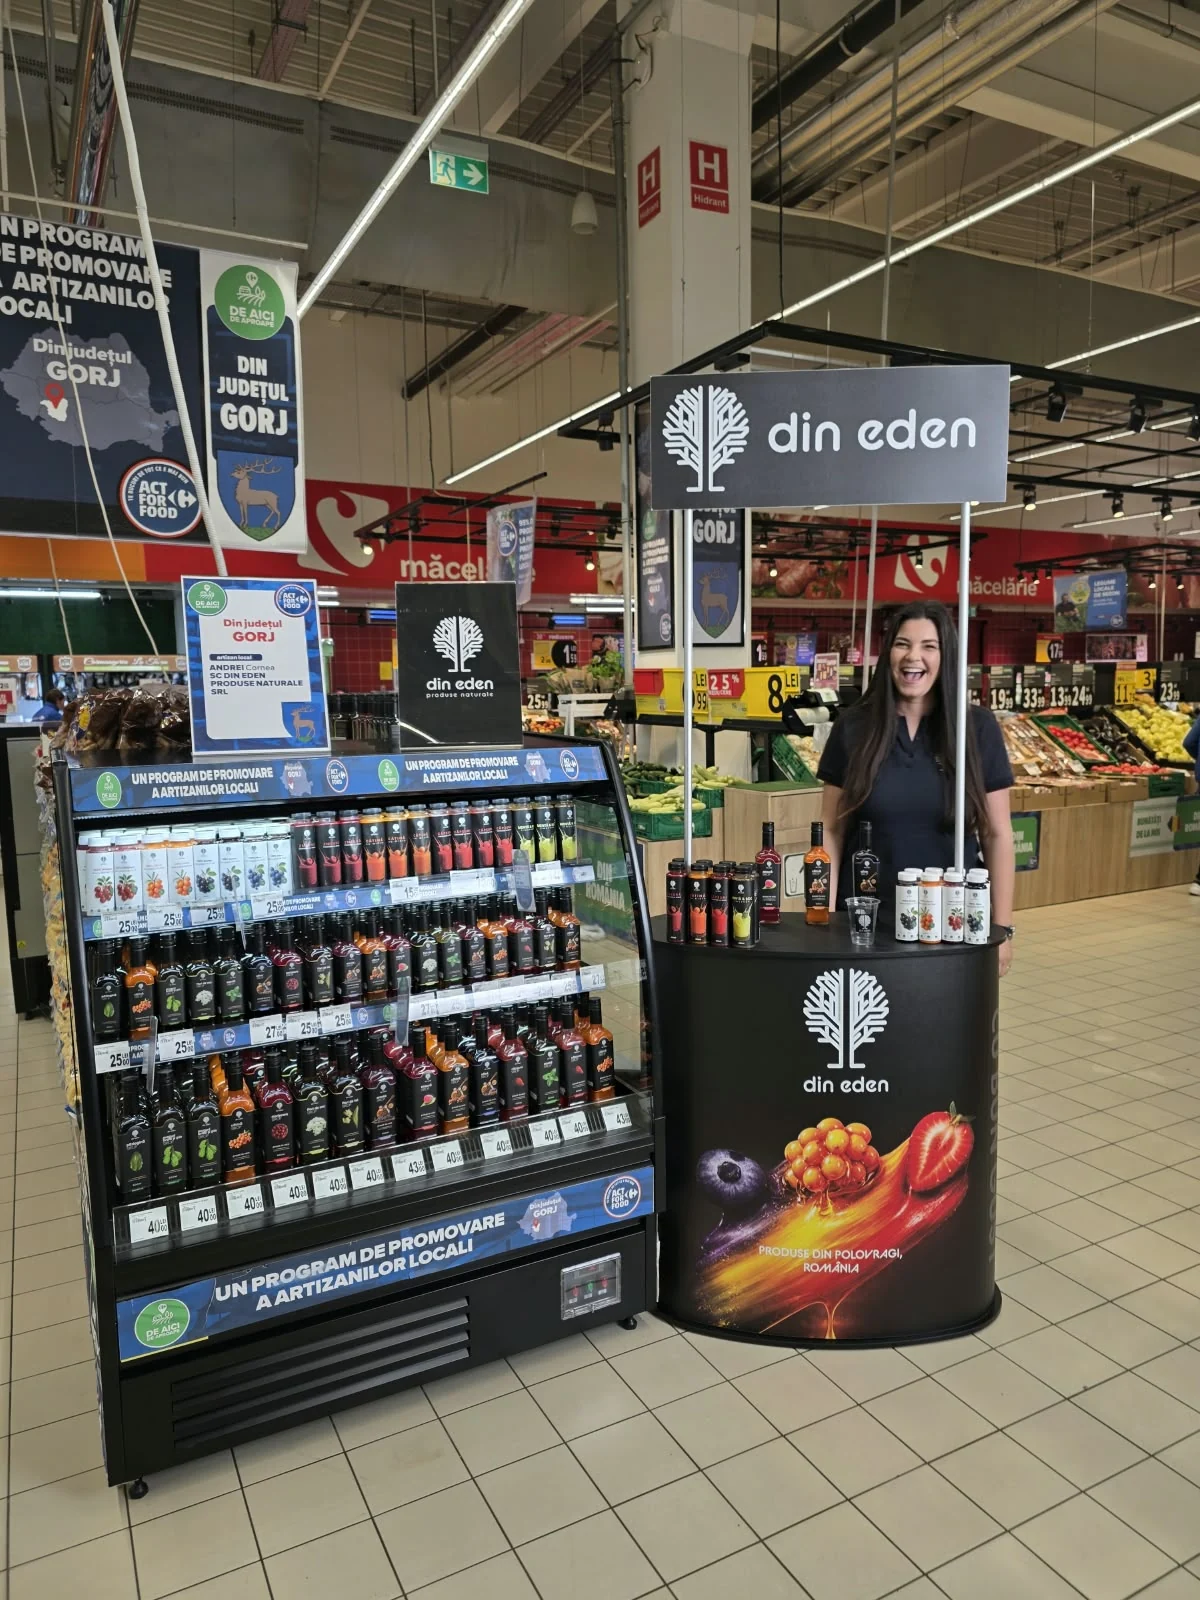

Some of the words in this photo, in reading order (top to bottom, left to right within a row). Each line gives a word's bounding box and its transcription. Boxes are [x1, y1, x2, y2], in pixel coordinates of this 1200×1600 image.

[698, 150, 720, 183] H
[642, 157, 656, 197] H
[694, 193, 726, 208] Hidrant
[23, 219, 147, 259] PROGRAM
[0, 242, 17, 263] E
[0, 296, 72, 324] OCALI
[230, 305, 247, 318] DE
[249, 308, 274, 322] AICI
[34, 338, 66, 356] Din
[67, 342, 132, 366] județul
[238, 356, 267, 377] DIN
[46, 361, 121, 388] GORJ
[216, 378, 289, 405] JUDEȚUL
[220, 403, 289, 436] GORJ
[768, 411, 840, 453] din
[857, 408, 976, 451] eden
[139, 480, 168, 495] ACT
[138, 494, 167, 506] FOR
[140, 506, 178, 518] FOOD
[693, 519, 735, 544] GORJ
[224, 619, 242, 627] Din
[244, 619, 282, 630] județul
[232, 632, 275, 642] GORJ
[426, 678, 450, 691] din
[455, 677, 494, 690] eden
[696, 674, 706, 686] LEI
[1144, 672, 1151, 686] 3
[768, 674, 784, 714] 8
[786, 674, 798, 688] LEI
[1023, 688, 1038, 708] 33
[1050, 686, 1064, 706] 13
[1072, 686, 1086, 706] 24
[1116, 684, 1128, 703] 11
[1160, 682, 1173, 702] 23
[528, 694, 540, 709] 25
[696, 693, 706, 710] 99
[990, 689, 1006, 710] 19
[405, 761, 418, 771] UN
[418, 758, 459, 770] PROGRAM
[459, 758, 470, 768] DE
[470, 756, 518, 768] PROMOVARE
[132, 773, 148, 784] UN
[148, 771, 200, 784] PROGRAM
[200, 770, 213, 780] DE
[214, 766, 274, 780] PROMOVARE
[430, 772, 482, 783] ARTIZANILOR
[482, 769, 508, 780] LOCALI
[152, 788, 160, 798] A
[160, 784, 224, 798] ARTIZANILOR
[225, 782, 258, 794] LOCALI
[597, 860, 612, 882] DIN
[206, 907, 218, 920] 25
[266, 901, 278, 914] 25
[118, 920, 130, 934] 25
[164, 914, 176, 926] 25
[335, 1014, 346, 1027] 25
[266, 1026, 276, 1038] 27
[300, 1022, 312, 1034] 25
[175, 1040, 187, 1054] 25
[110, 1053, 122, 1067] 25
[803, 1076, 834, 1093] din
[840, 1076, 888, 1093] eden
[616, 1114, 626, 1124] 43
[574, 1122, 583, 1134] 40
[544, 1130, 554, 1142] 40
[496, 1140, 506, 1152] 40
[446, 1152, 456, 1164] 40
[408, 1161, 418, 1174] 43
[366, 1170, 376, 1182] 40
[330, 1178, 340, 1192] 40
[290, 1186, 300, 1199] 40
[612, 1188, 625, 1197] ACT
[612, 1194, 624, 1204] FOR
[244, 1196, 256, 1210] 40
[612, 1200, 629, 1210] FOOD
[198, 1208, 210, 1222] 40
[533, 1206, 558, 1218] GORJ
[148, 1220, 160, 1234] 40
[215, 1280, 248, 1302] UN
[252, 1250, 357, 1292] PROGRAM
[360, 1242, 385, 1264] DE
[395, 1212, 505, 1252] PROMOVARE
[759, 1246, 808, 1258] PRODUSE
[812, 1249, 832, 1260] DIN
[834, 1248, 902, 1260] POLOVRAGI,
[804, 1261, 859, 1273] ROMÂNIA
[256, 1294, 274, 1312] A
[274, 1256, 407, 1306] ARTIZANILOR
[409, 1238, 473, 1269] LOCALI
[146, 1329, 160, 1338] DE
[162, 1322, 180, 1334] AICI
